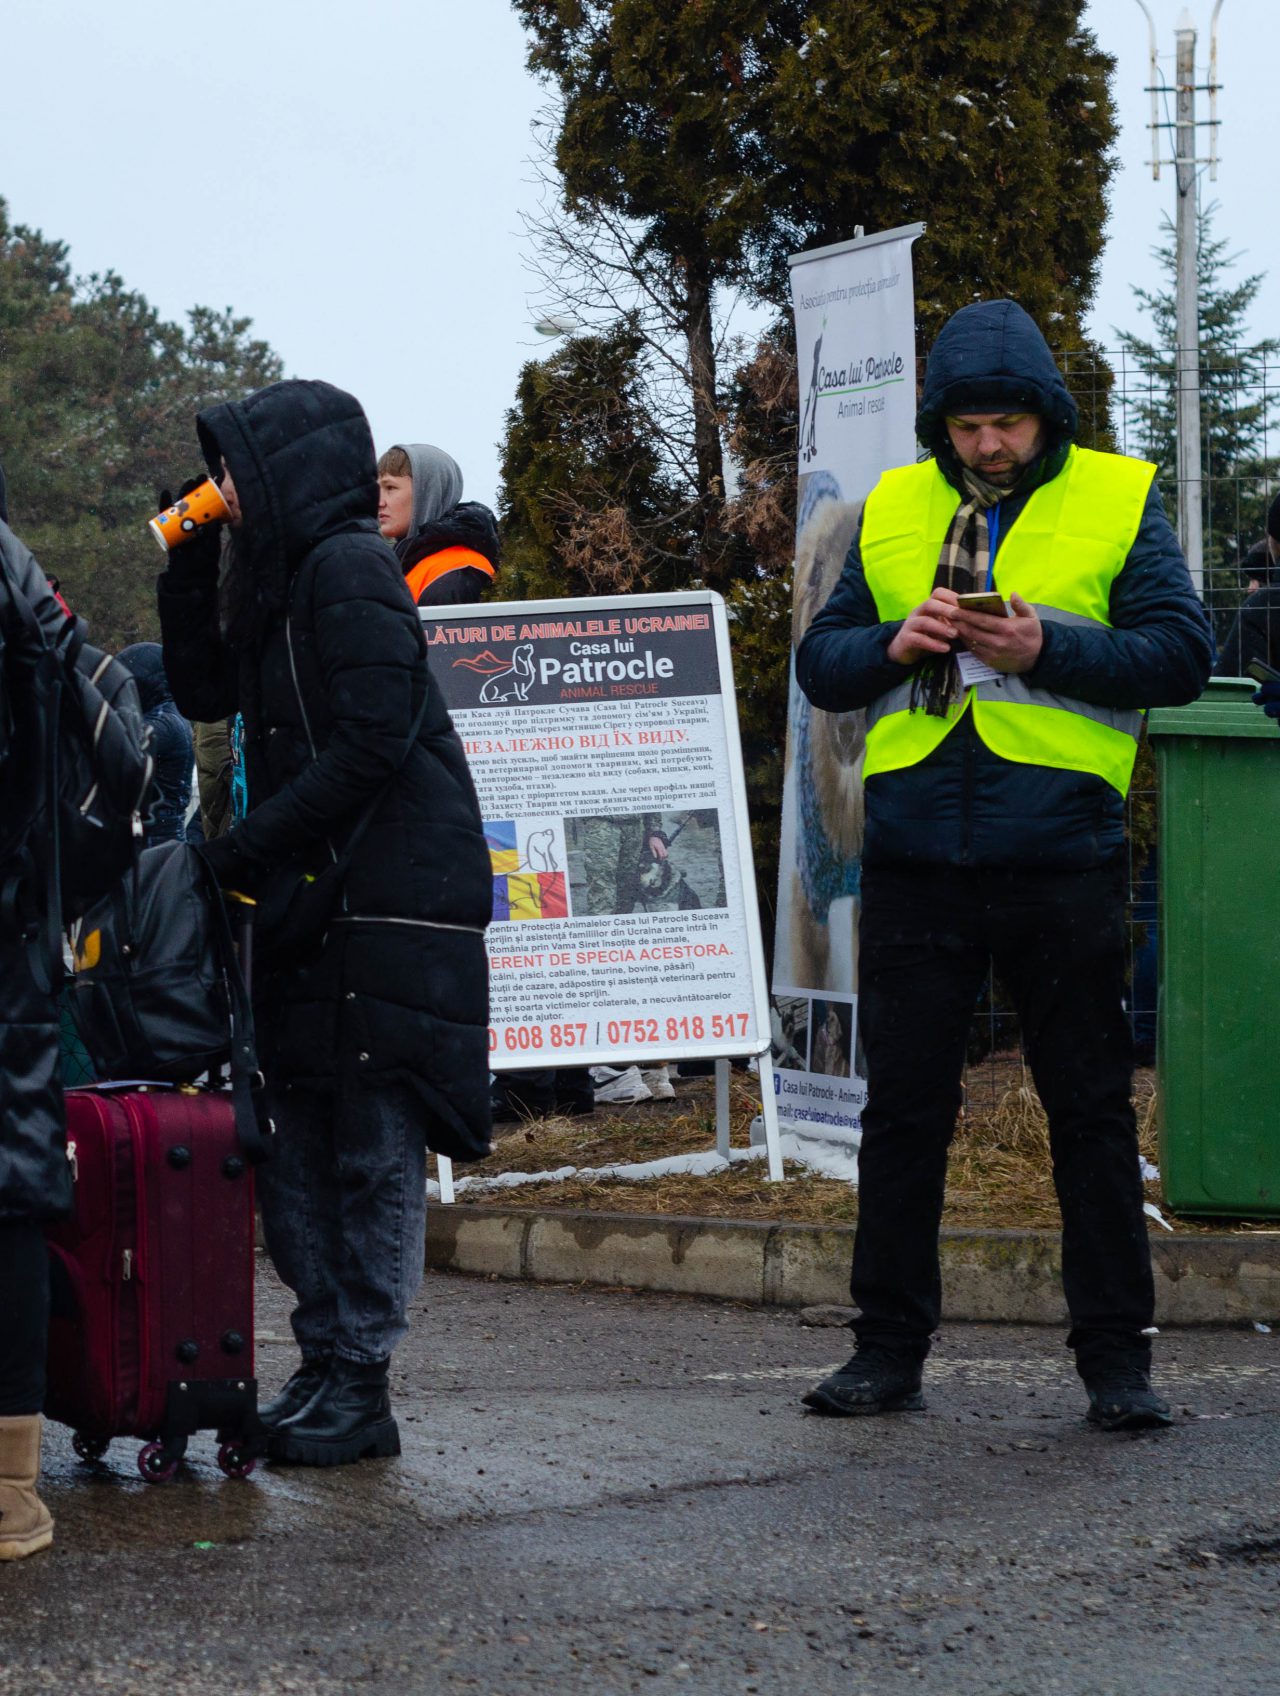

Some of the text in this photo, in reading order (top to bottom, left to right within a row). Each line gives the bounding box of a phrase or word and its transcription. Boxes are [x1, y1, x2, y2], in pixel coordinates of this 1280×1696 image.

[817, 366, 846, 393] Casa
[849, 360, 863, 383] lui
[837, 398, 865, 419] Animal
[425, 614, 709, 645] LĂTURI DE ANIMALELE UCRAINEI
[569, 638, 634, 656] Casa lui
[539, 650, 674, 685] Patrocle
[560, 683, 658, 699] ANIMAL RESCUE
[472, 710, 491, 718] Каса
[514, 707, 555, 717] Патрокле
[559, 705, 590, 715] Сучава
[594, 703, 616, 713] (Casa
[672, 698, 708, 708] Suceava)
[468, 720, 509, 729] оголошує
[532, 715, 574, 725] підтримку
[592, 713, 631, 722] допомогу
[538, 726, 560, 734] через
[604, 721, 625, 730] Сірет
[464, 729, 689, 754] НЕЗАЛЕЖНО ВІД ЇХ ВИДУ.
[542, 754, 558, 763] щоб
[552, 763, 592, 771] допомоги
[596, 760, 641, 769] тваринам,
[661, 755, 712, 765] потребують
[588, 770, 600, 779] від
[625, 767, 659, 776] (собаки,
[495, 782, 556, 793] худоба, птахи).
[629, 787, 651, 795] через
[654, 783, 687, 793] профіль
[490, 802, 522, 811] Захисту
[526, 800, 557, 809] Тварин
[654, 792, 696, 802] пріоритет
[699, 791, 716, 800] долі
[581, 806, 630, 815] потребують
[632, 804, 674, 812] допомоги.
[490, 925, 518, 935] pentru
[563, 919, 610, 928] Animalelor
[614, 918, 636, 926] Casa
[652, 915, 688, 923] Patrocle
[692, 912, 729, 921] Suceava
[484, 935, 512, 945] sprijin
[611, 928, 624, 936] din
[628, 926, 662, 935] Ucraina
[490, 935, 690, 953] România prin Vama Siret de animale,
[490, 944, 733, 969] ERENT DE SPECIA ACESTORA.
[520, 970, 546, 981] pisici,
[549, 968, 589, 979] cabaline,
[592, 966, 626, 976] taurine,
[628, 964, 661, 974] bovine,
[526, 984, 557, 992] cazare,
[560, 979, 606, 990] adăpostire
[707, 971, 735, 982] pentru
[534, 992, 563, 1000] nevoie
[580, 989, 610, 999] sprijin.
[515, 1003, 543, 1011] soarta
[546, 1001, 590, 1009] victimelor
[593, 998, 639, 1009] colaterale,
[490, 1012, 564, 1023] nevoie de ajutor.
[488, 1013, 748, 1051] 0 608 857 0752 818 517
[783, 1080, 797, 1094] Casa
[799, 1081, 807, 1095] lui
[808, 1084, 833, 1100] Patrocle
[838, 1088, 863, 1104] Animal
